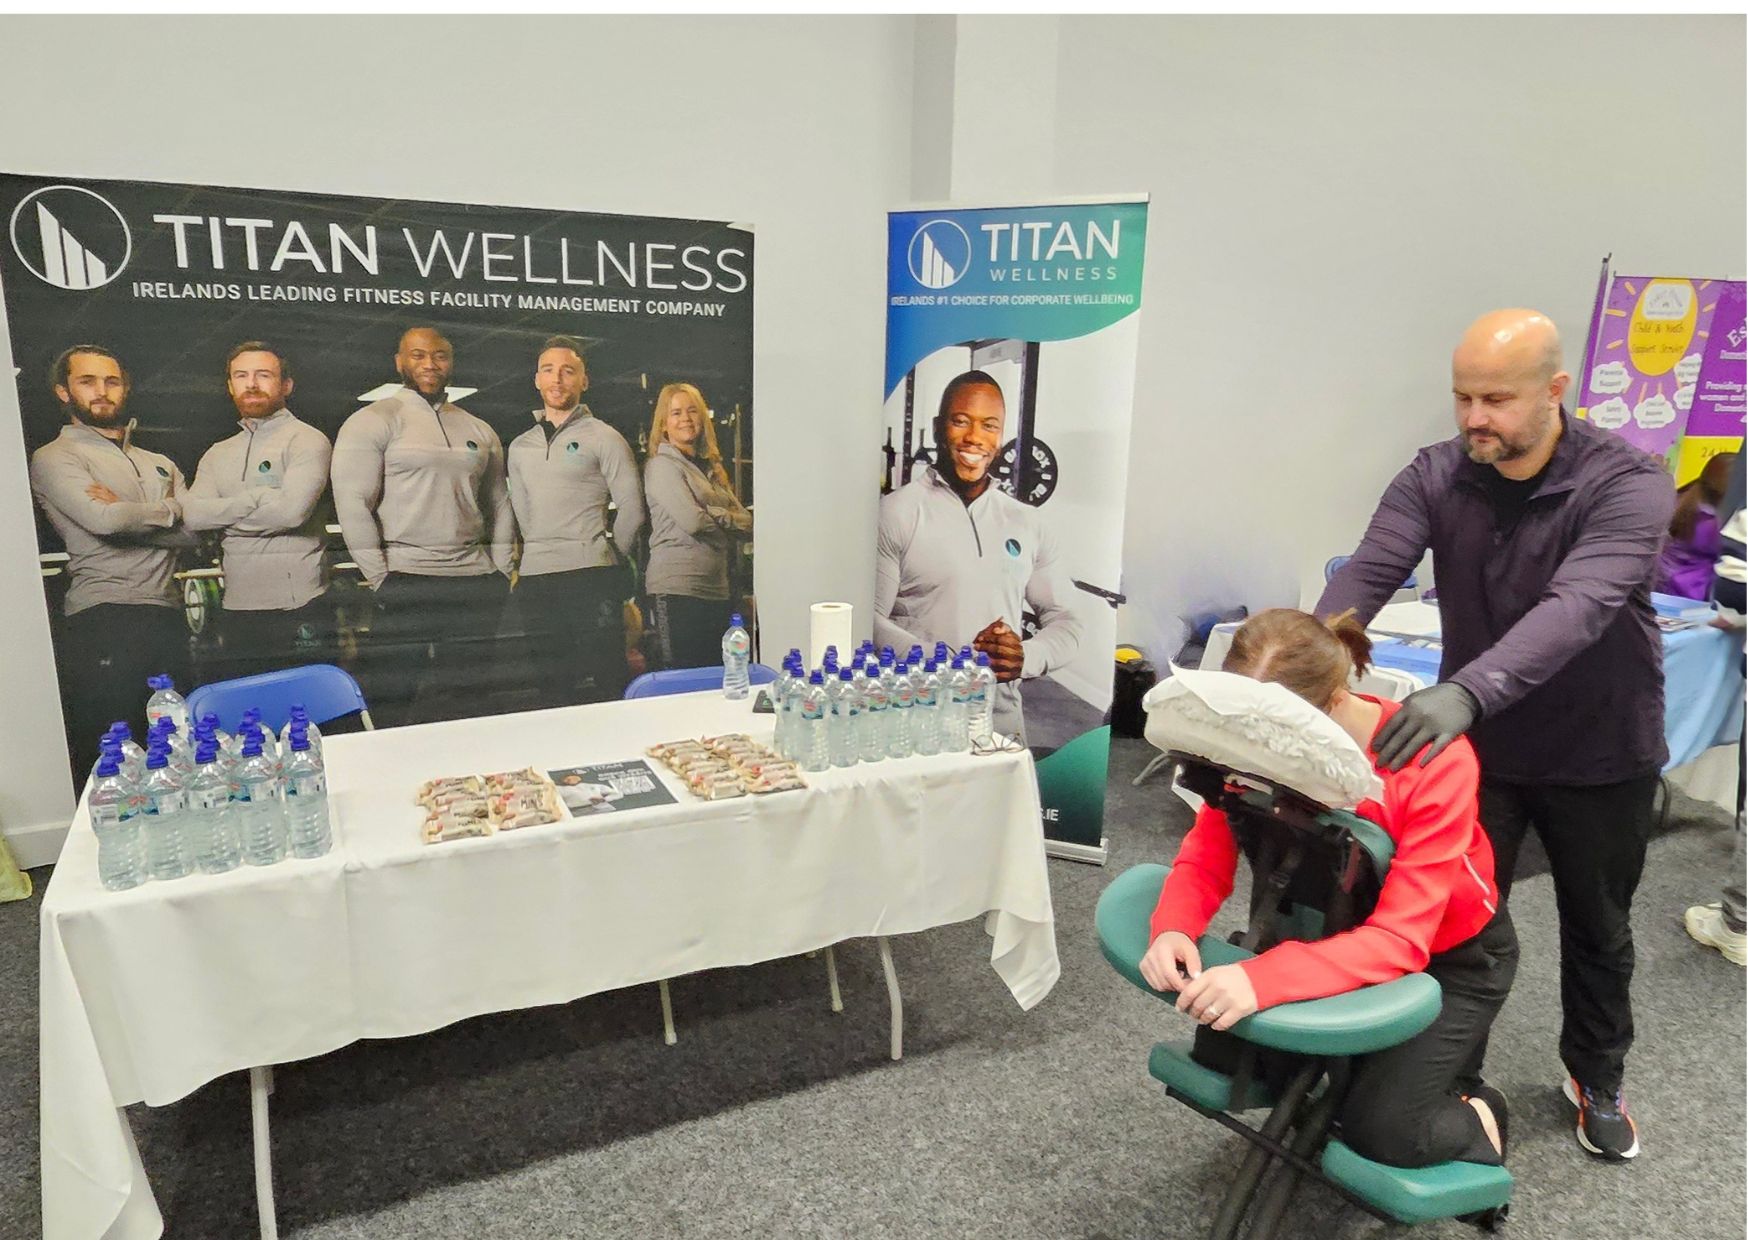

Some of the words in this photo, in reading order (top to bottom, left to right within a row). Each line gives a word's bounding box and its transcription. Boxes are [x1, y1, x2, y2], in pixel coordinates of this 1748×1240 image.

[153, 214, 379, 276] TITAN
[402, 227, 747, 293] WELLNESS
[981, 219, 1120, 262] TITAN
[989, 266, 1117, 282] WELLNESS
[132, 281, 242, 301] IRELANDS
[248, 284, 337, 303] LEADING
[344, 287, 424, 306] FITNESS
[430, 291, 512, 309] FACILITY
[518, 295, 641, 314] MANAGEMENT
[646, 300, 726, 317] COMPANY
[890, 295, 935, 306] IRELANDS
[937, 295, 948, 306] #1
[951, 295, 988, 306] CHOICE
[989, 294, 1010, 305] FOR
[1011, 294, 1072, 306] CORPORATE
[1073, 293, 1134, 305] WELLBEING
